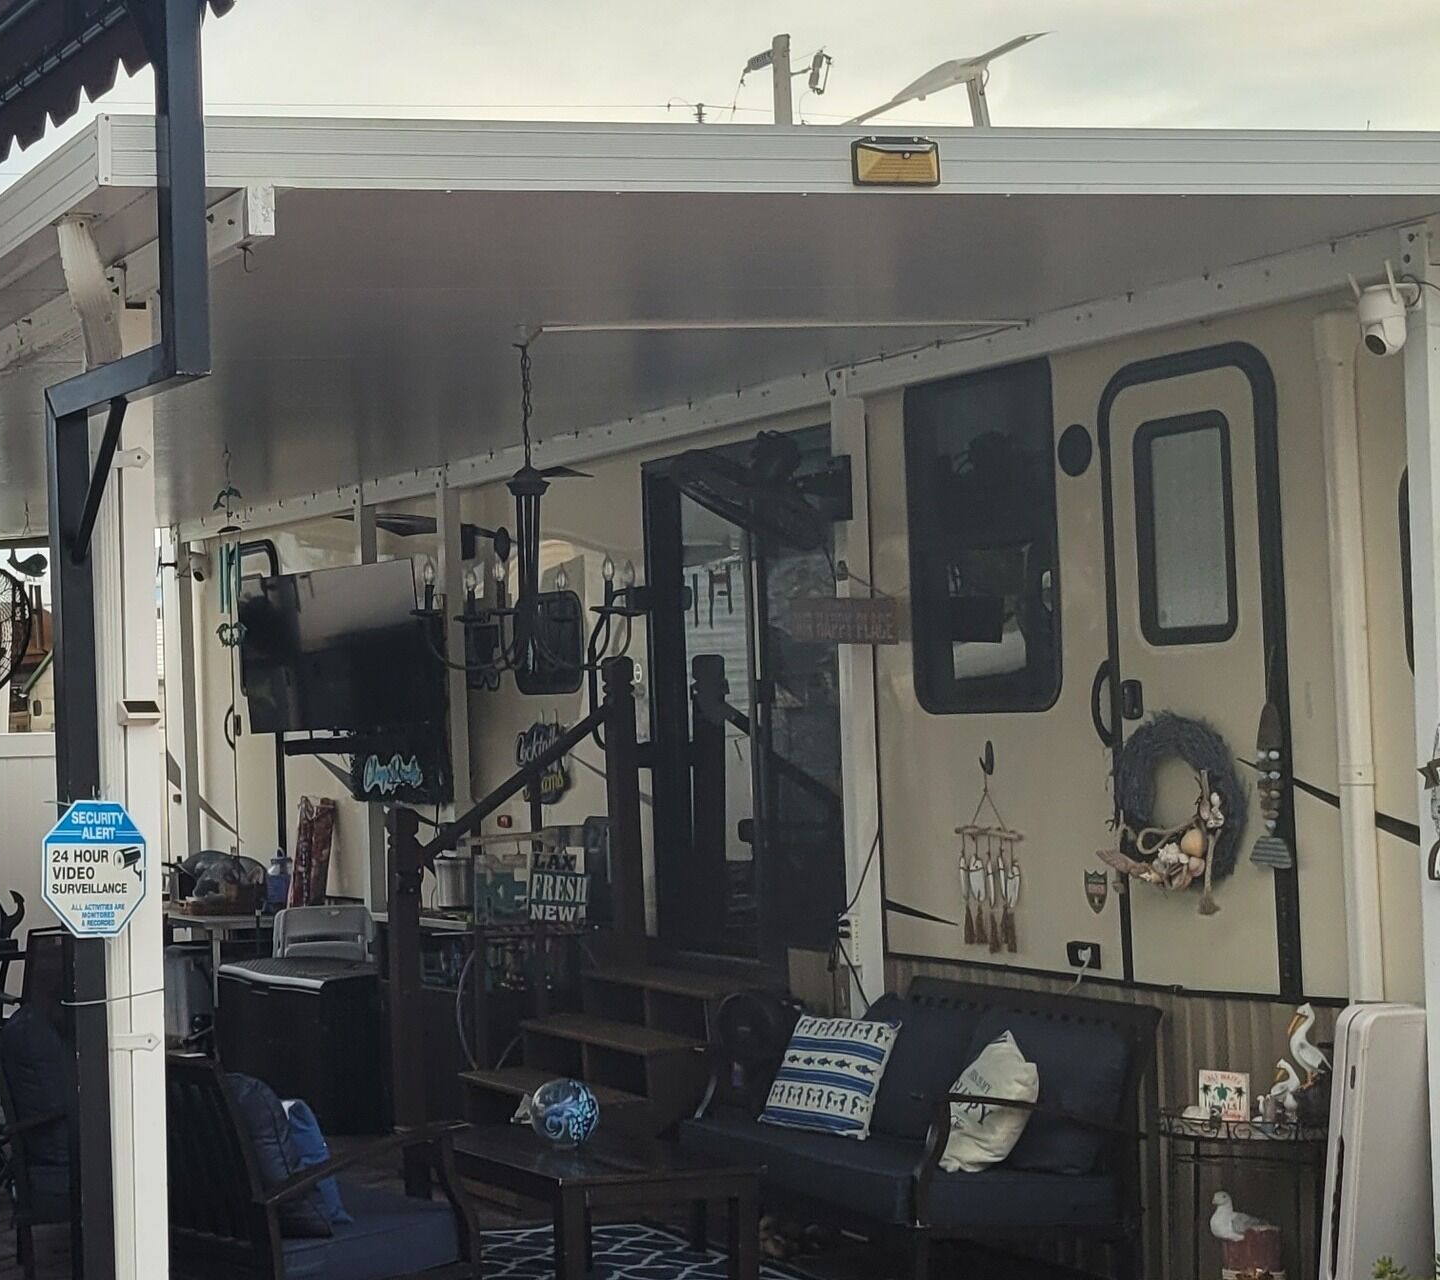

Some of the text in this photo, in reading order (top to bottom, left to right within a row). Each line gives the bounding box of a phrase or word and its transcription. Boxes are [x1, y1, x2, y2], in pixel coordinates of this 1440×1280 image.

[71, 811, 124, 825] SECURITY
[81, 827, 116, 840] ALERT
[52, 850, 109, 863] 24 HOUR
[53, 867, 95, 880] VIDEO
[52, 883, 127, 894] SURVEILLANCE
[531, 873, 587, 903] FRESH
[529, 904, 577, 922] NEW
